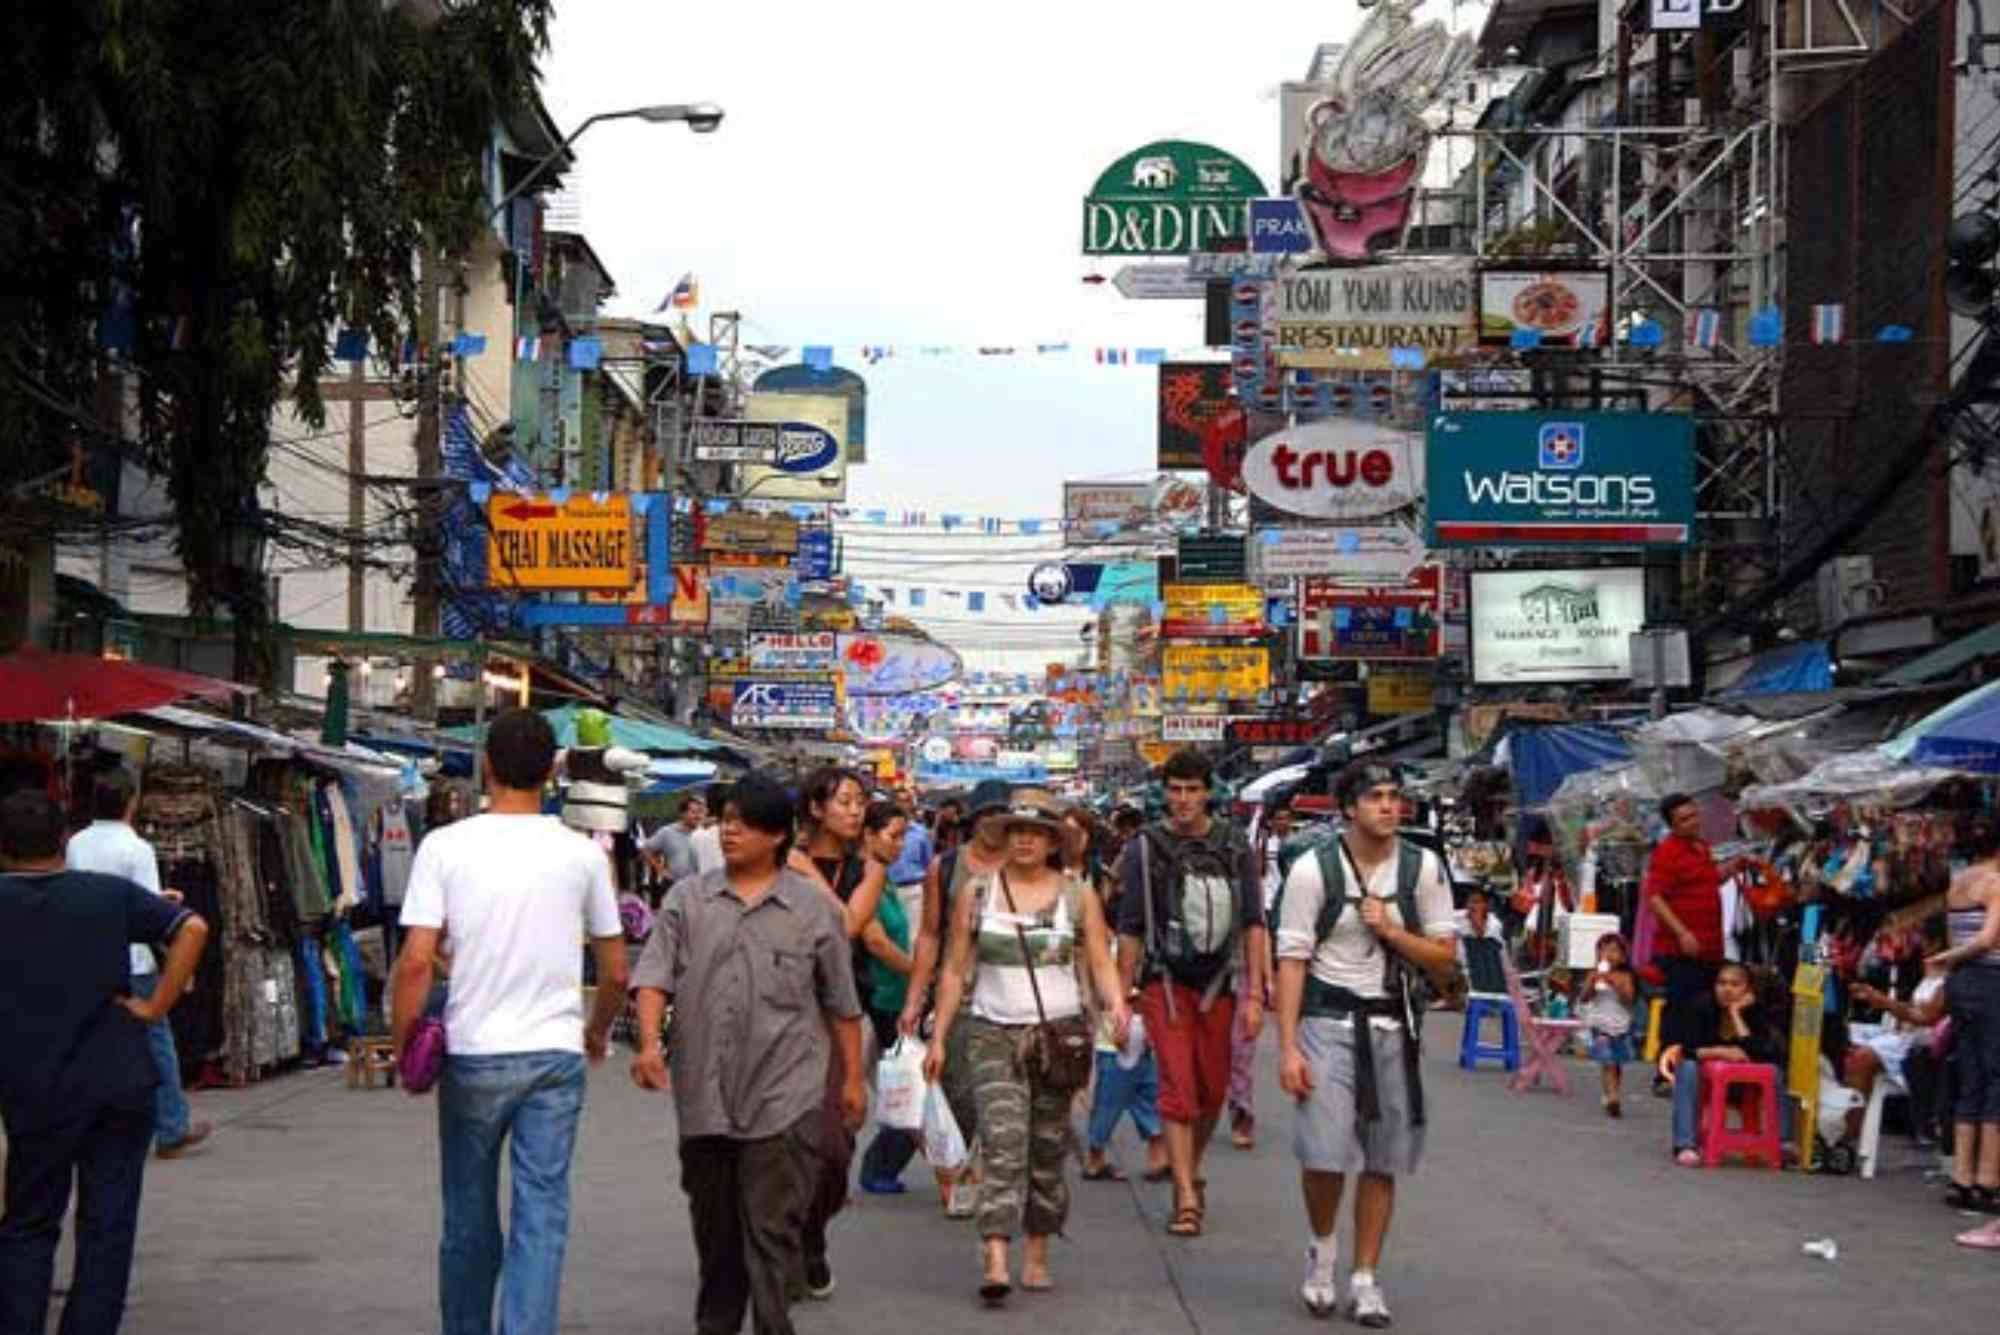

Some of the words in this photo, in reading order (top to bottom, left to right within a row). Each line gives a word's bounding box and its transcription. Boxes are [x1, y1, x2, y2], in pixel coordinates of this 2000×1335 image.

[1086, 201, 1184, 251] D&D
[1188, 201, 1248, 251] IN
[1282, 278, 1331, 313] TOM
[1341, 274, 1392, 313] YUM
[1402, 272, 1468, 312] KUNG
[1279, 325, 1460, 349] RESTAURANT
[1271, 443, 1395, 490] true
[497, 529, 539, 569] THAI
[546, 529, 625, 569] MASSAGE
[768, 633, 834, 649] HELLO
